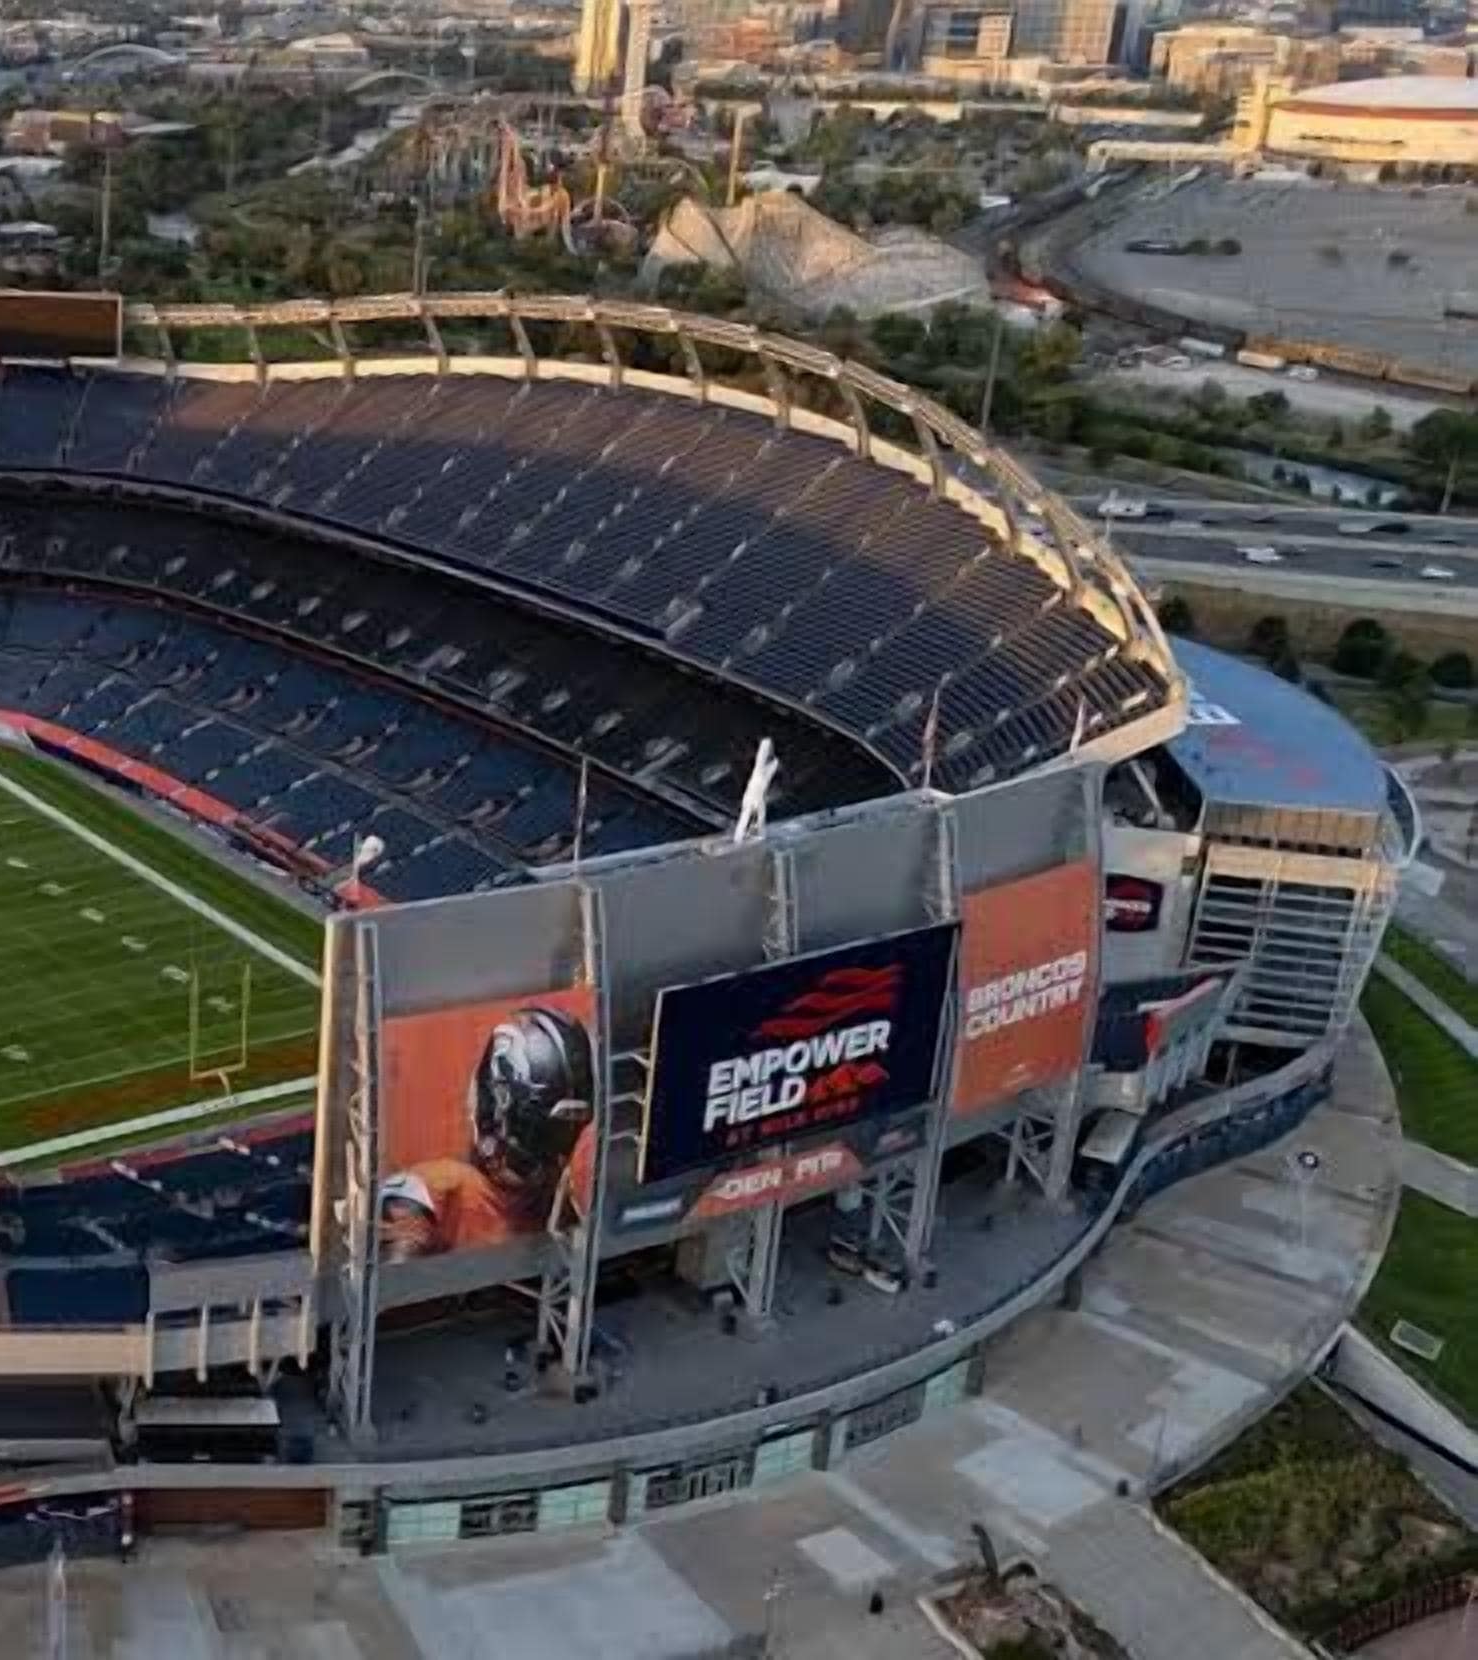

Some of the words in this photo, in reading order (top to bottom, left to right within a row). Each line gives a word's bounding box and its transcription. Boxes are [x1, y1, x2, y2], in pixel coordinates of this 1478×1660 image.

[965, 974, 1083, 1040] COUNTRY
[967, 951, 1087, 1013] BRONCOS
[707, 1020, 891, 1096] EMPOWER
[703, 1075, 807, 1132] FIELD
